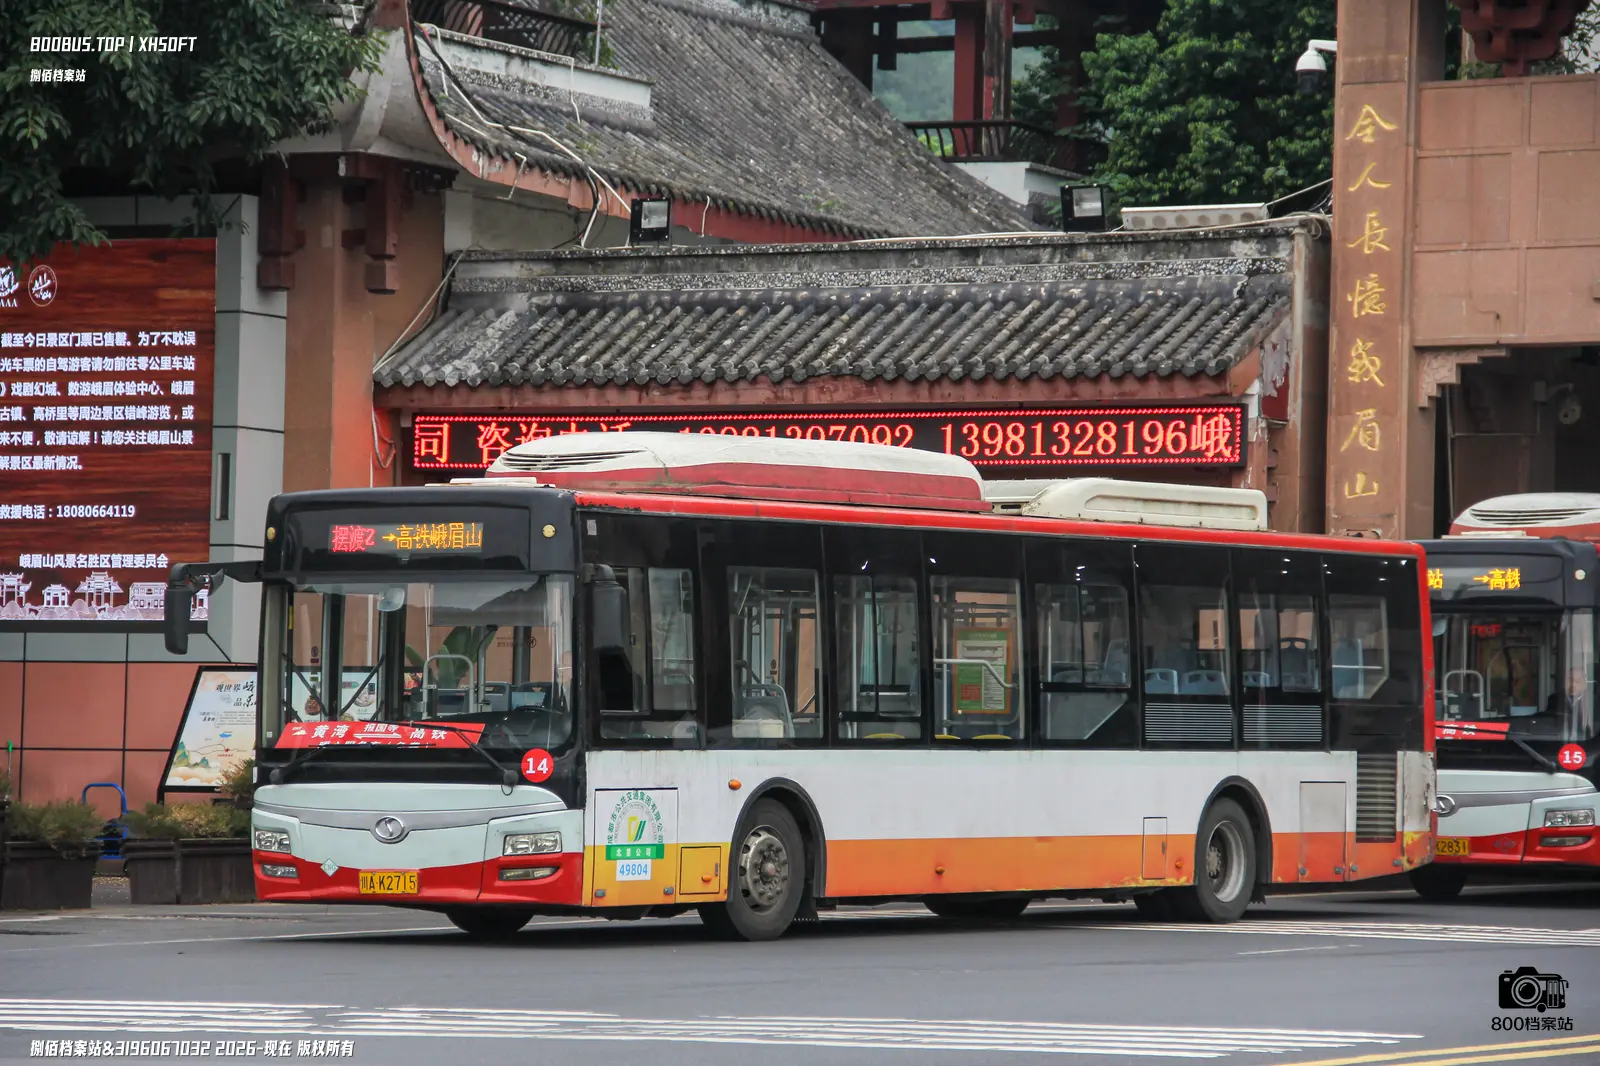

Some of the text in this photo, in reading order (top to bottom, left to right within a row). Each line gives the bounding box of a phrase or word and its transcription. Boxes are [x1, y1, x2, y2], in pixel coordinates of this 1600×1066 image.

[0, 356, 195, 372] 光车票的自驾游客请勿前往零公里车站
[417, 422, 450, 463] 司
[332, 522, 483, 552] 摆渡2 高铁峨眉山
[19, 553, 169, 569] 峨眉山风景名胜区管理委员会
[1488, 568, 1520, 590] 高铁
[311, 724, 350, 739] 黄湾
[525, 756, 549, 774] 14
[1562, 750, 1583, 764] 15
[619, 864, 649, 876] 49804
